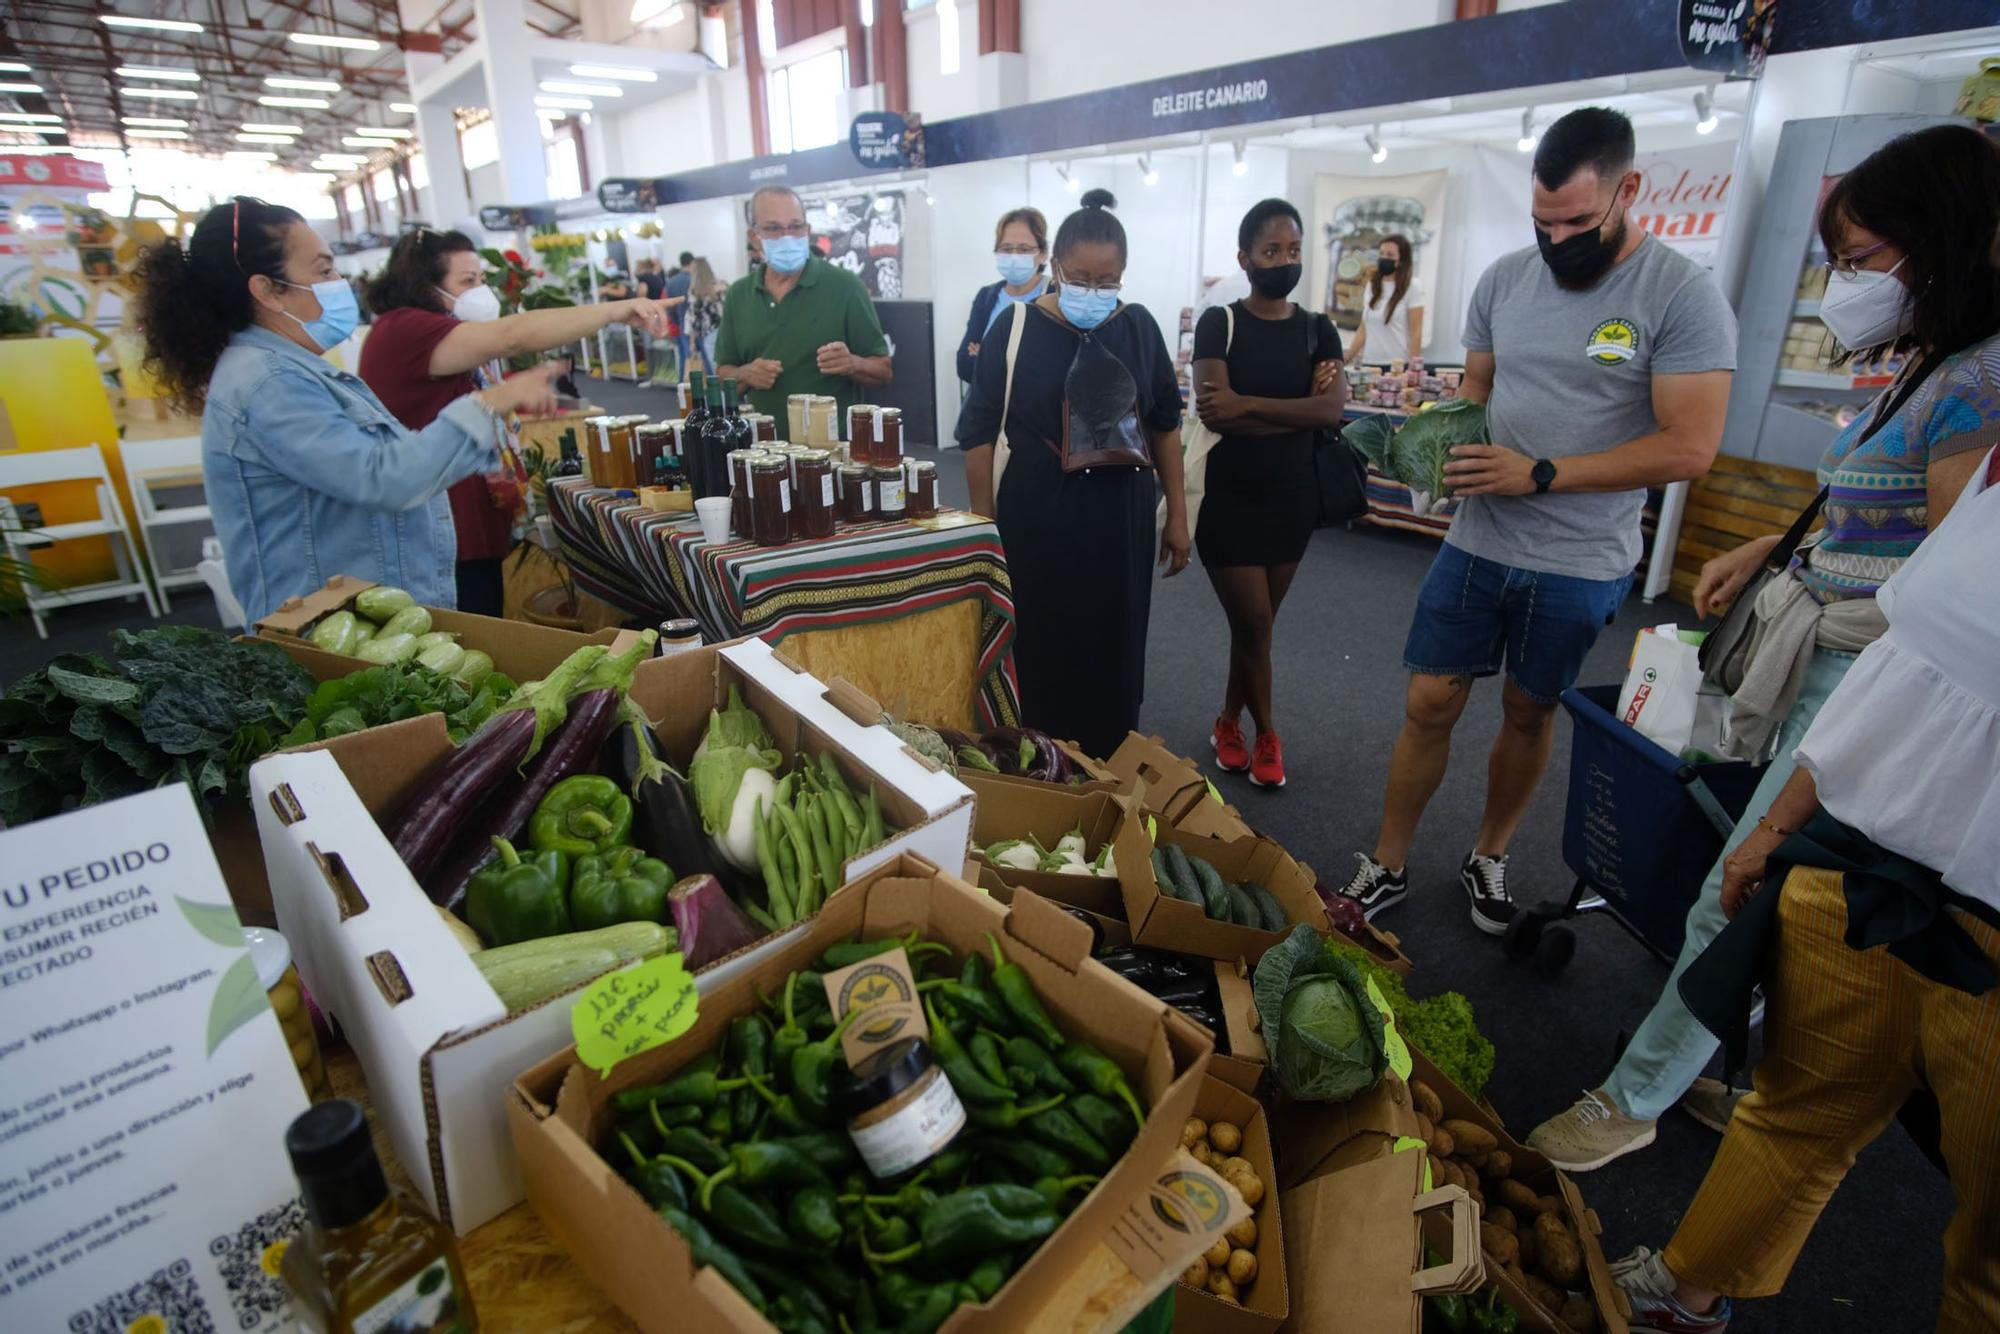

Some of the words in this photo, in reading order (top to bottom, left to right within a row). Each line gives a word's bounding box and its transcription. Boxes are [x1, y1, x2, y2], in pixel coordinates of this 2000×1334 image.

[1704, 8, 1740, 55] gusta
[1152, 90, 1204, 117] DELEITE
[1205, 79, 1268, 109] CANARIO
[1624, 684, 1652, 726] PAR
[0, 883, 30, 908] U
[40, 842, 170, 898] PEDIDO
[3, 884, 151, 942] EXPERIENCIA
[0, 945, 93, 988] ECTADO
[31, 1004, 117, 1042] Whatsapp
[120, 999, 131, 1010] o
[23, 1093, 57, 1112] con
[59, 1080, 86, 1097] los
[90, 1046, 172, 1087] productos
[73, 1091, 104, 1111] esa
[29, 1152, 74, 1182] junto
[79, 1146, 90, 1157] a
[93, 1131, 125, 1150] una
[128, 1095, 204, 1135] dirección
[207, 1091, 215, 1103] y
[218, 1073, 254, 1094] elige
[5, 1255, 30, 1273] de
[34, 1214, 113, 1257] verduras
[115, 1183, 178, 1217] frescas
[16, 1261, 57, 1287] está
[60, 1248, 83, 1265] en
